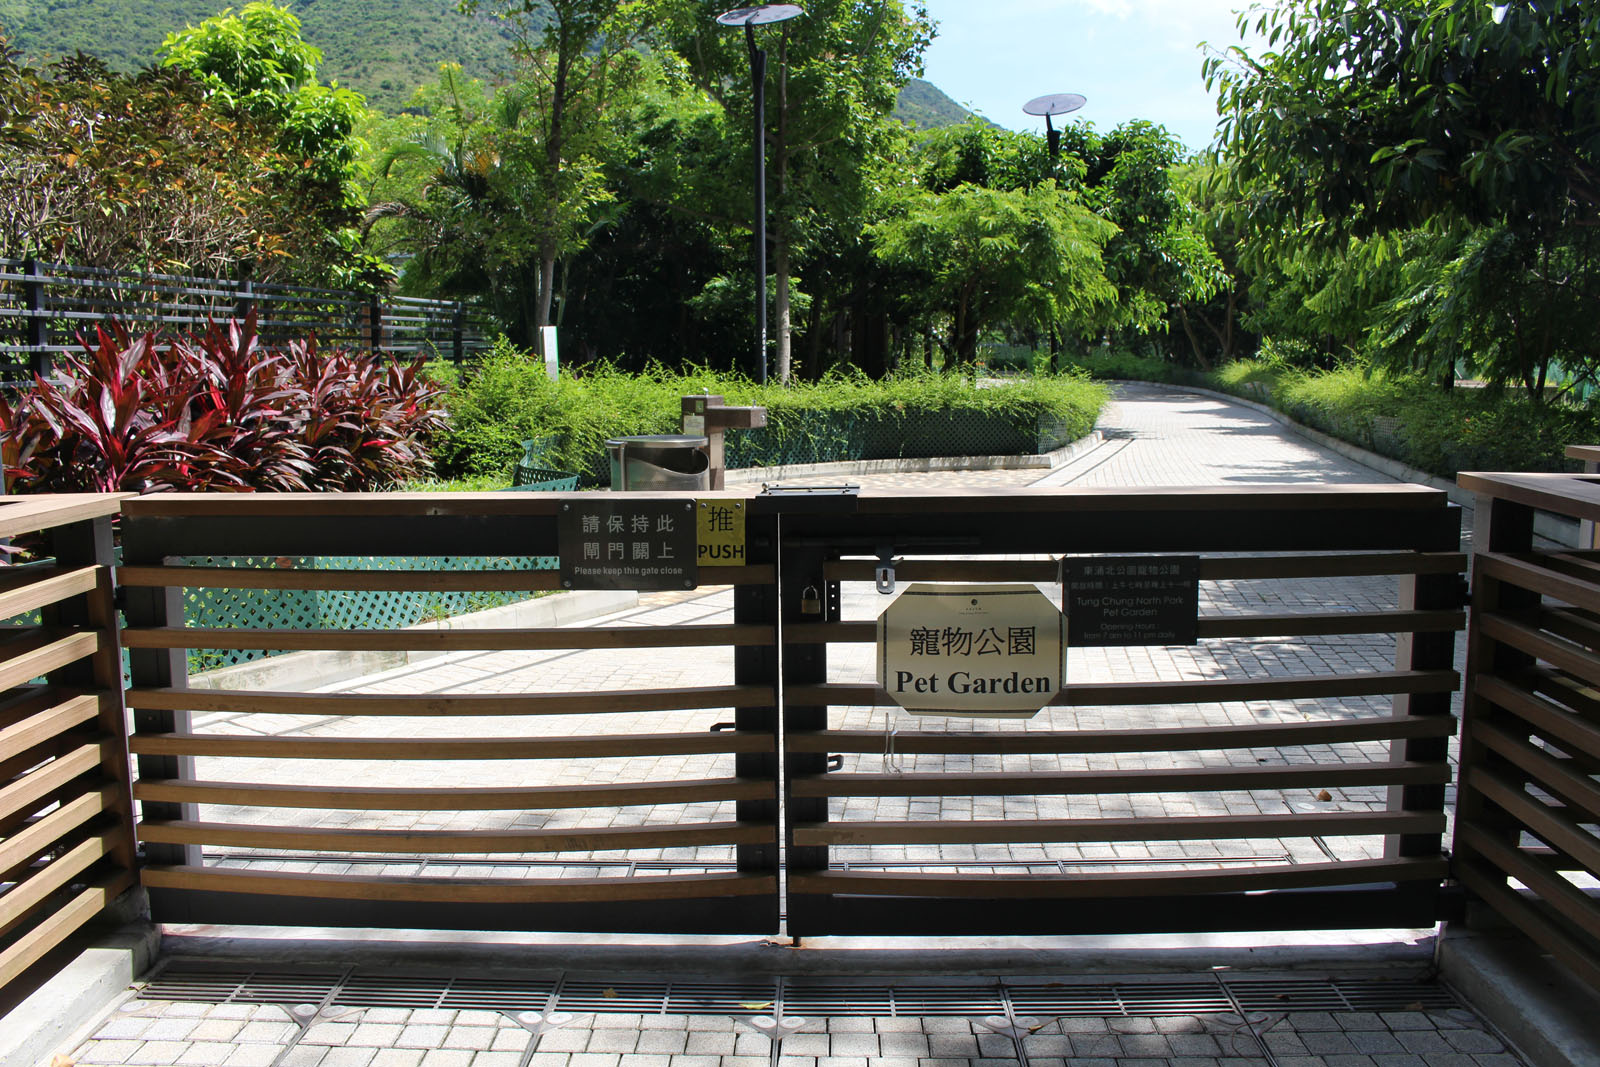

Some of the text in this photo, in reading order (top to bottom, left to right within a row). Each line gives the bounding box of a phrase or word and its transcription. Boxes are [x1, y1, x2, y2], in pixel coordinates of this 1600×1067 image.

[581, 514, 674, 534] 請保持此
[708, 506, 734, 532] 推
[583, 542, 675, 560] 閘門關上
[697, 544, 744, 559] PUSH
[574, 566, 683, 576] Please keep this gate close
[1076, 595, 1184, 607] Tung Chung North Park
[1103, 608, 1157, 617] Pet Garden
[1100, 623, 1134, 631] Opening
[910, 626, 1036, 656] 寵物公園
[895, 671, 1051, 694] Pet Garden
